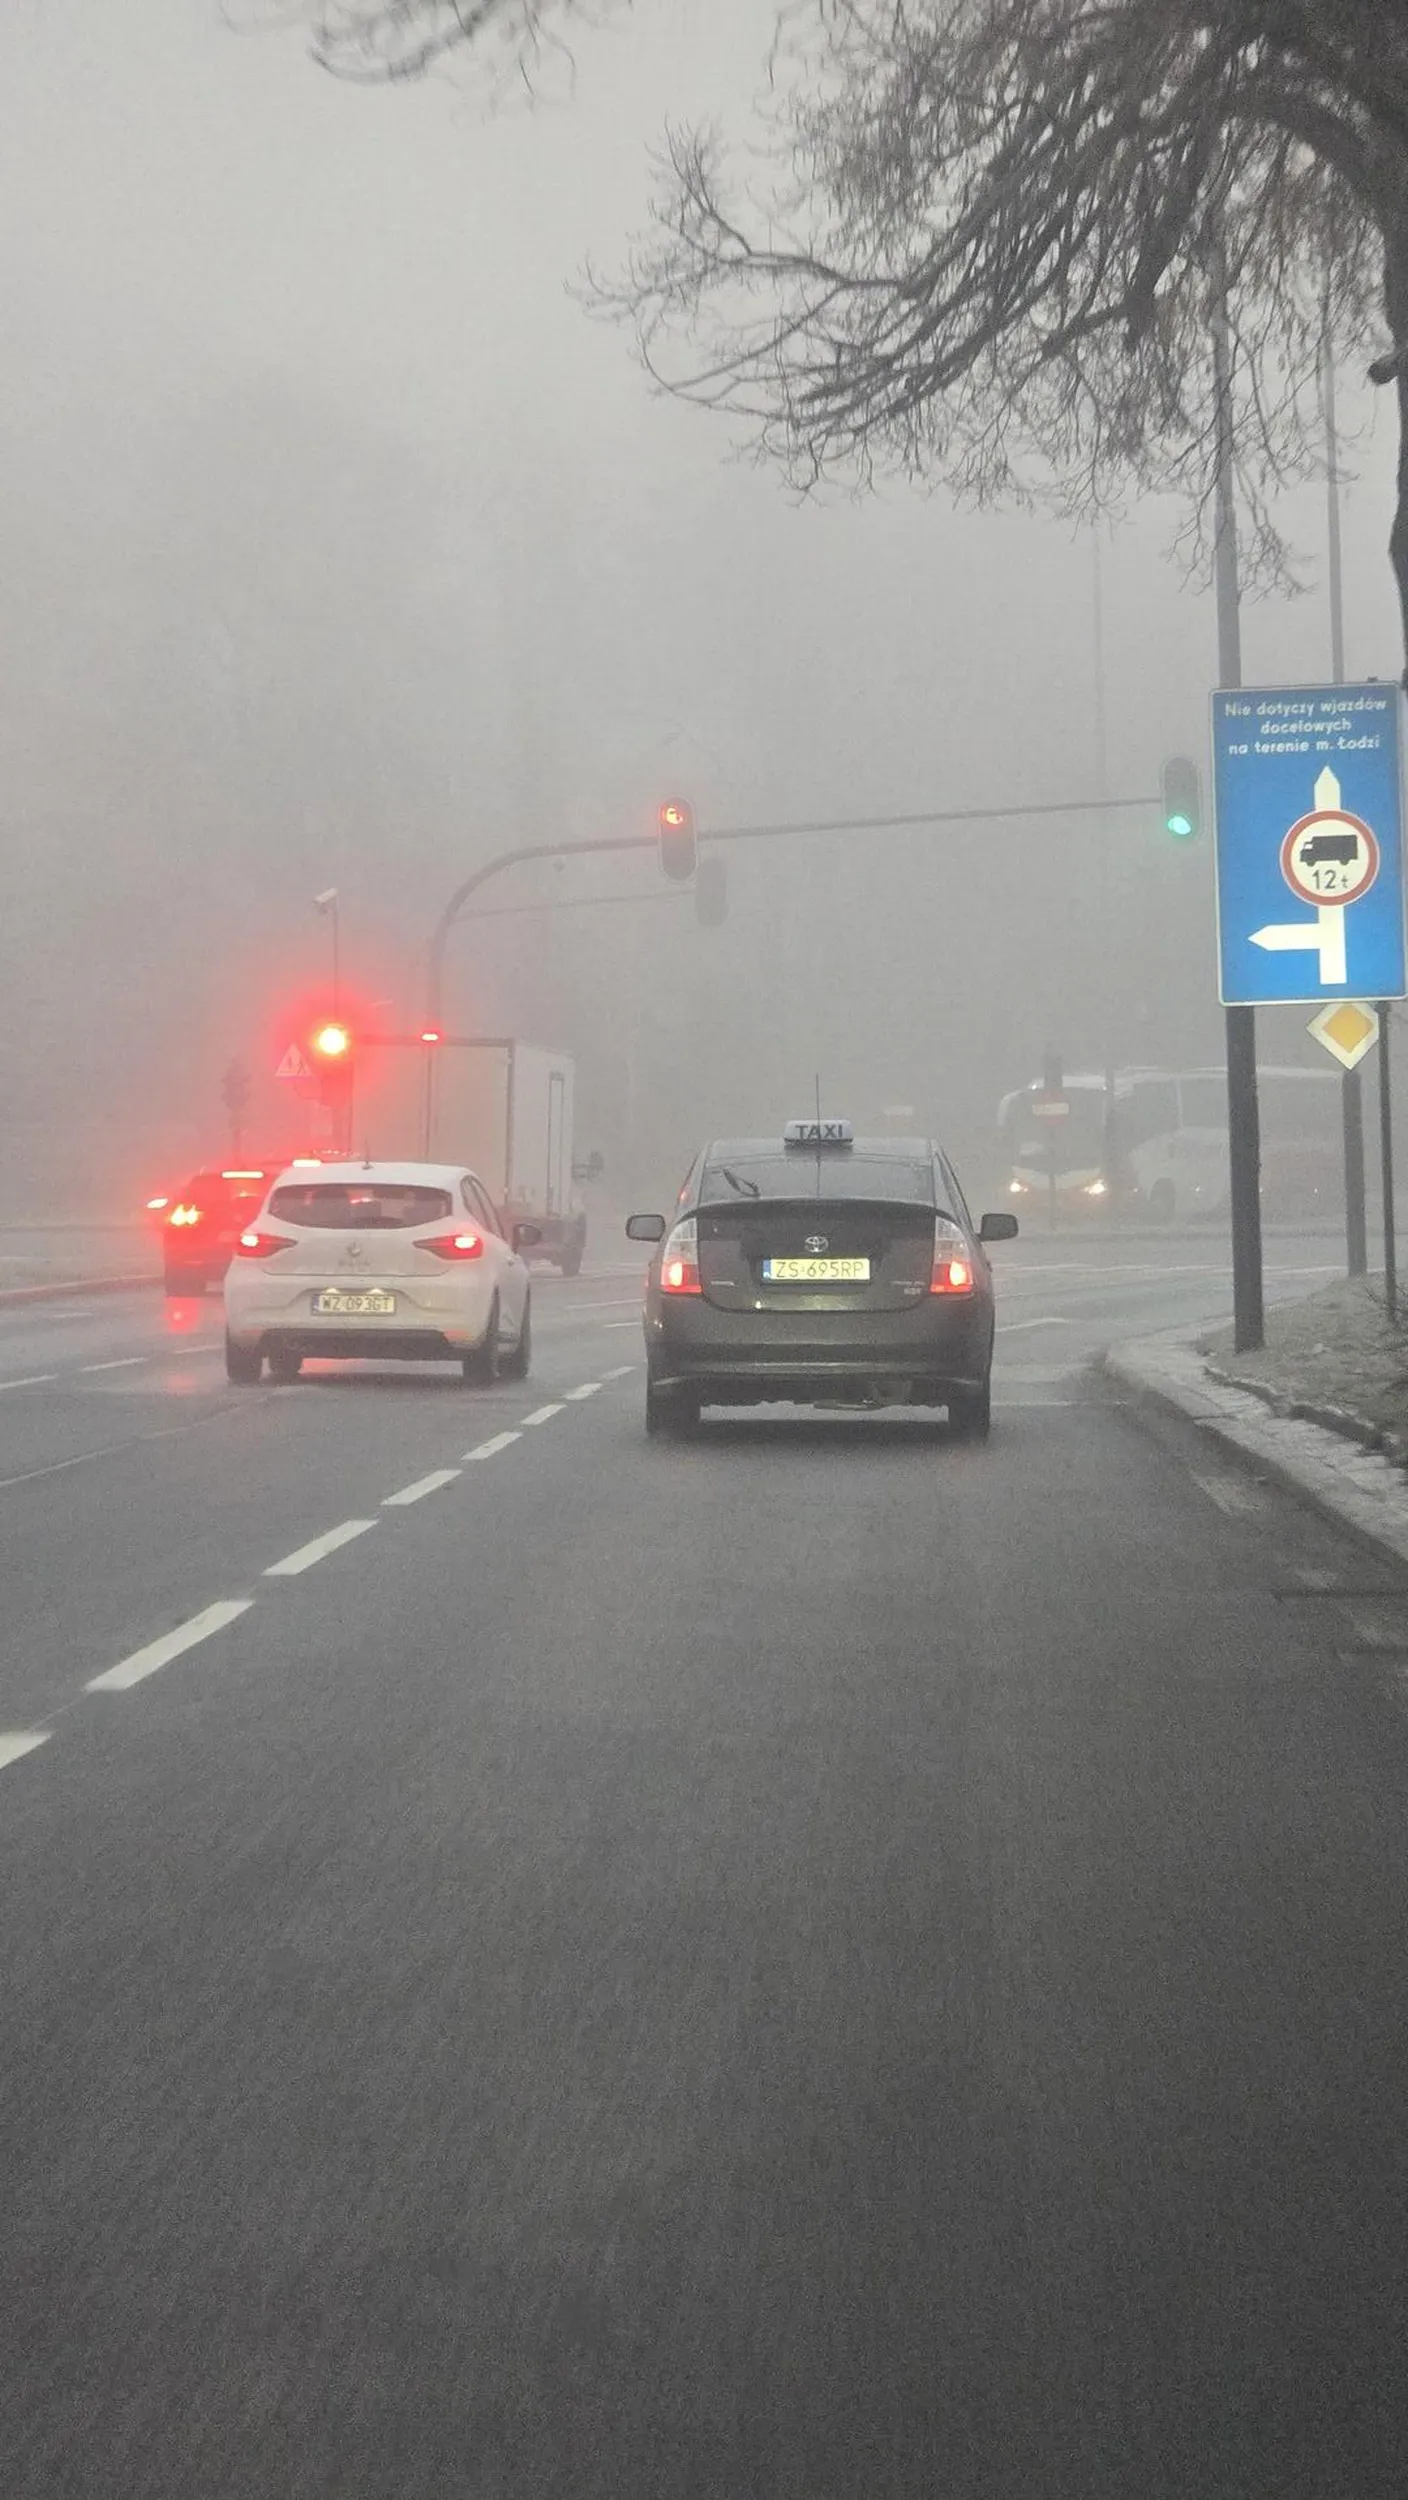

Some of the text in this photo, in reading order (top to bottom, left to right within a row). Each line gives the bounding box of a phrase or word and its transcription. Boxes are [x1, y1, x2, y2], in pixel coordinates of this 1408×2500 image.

[1225, 697, 1387, 717] Nie dotyczy wjazdów
[1260, 718, 1352, 734] docelowych
[1228, 735, 1380, 755] na terenie m. Łodzi
[795, 1124, 843, 1140] TAXI
[775, 1261, 864, 1278] ZS 695RP
